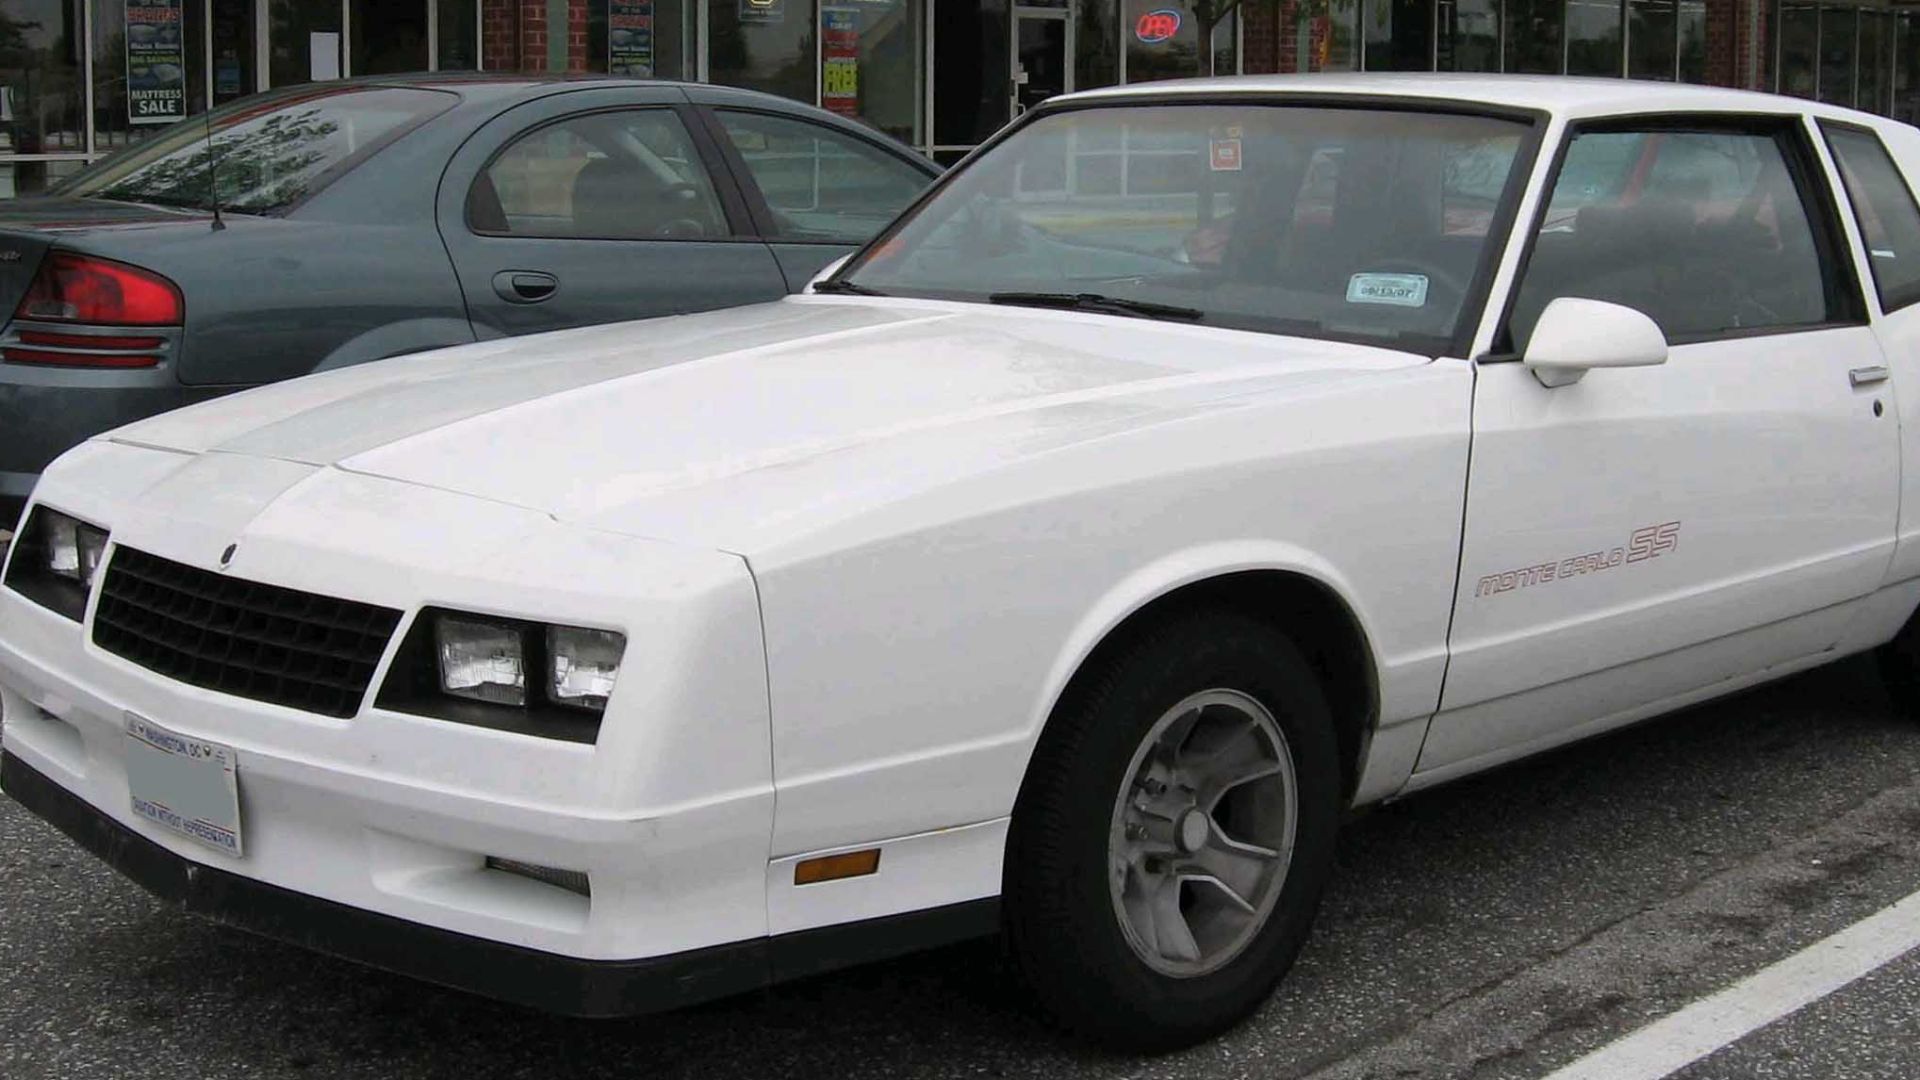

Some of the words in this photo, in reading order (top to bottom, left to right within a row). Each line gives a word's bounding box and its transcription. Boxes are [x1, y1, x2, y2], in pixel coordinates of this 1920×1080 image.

[1136, 14, 1176, 37] OPEN
[823, 63, 857, 92] FREE
[131, 89, 181, 100] MATTRESS
[139, 100, 176, 114] SALE
[1475, 562, 1557, 597] MONTE
[1558, 546, 1624, 579] CARLO
[1626, 521, 1681, 563] SS
